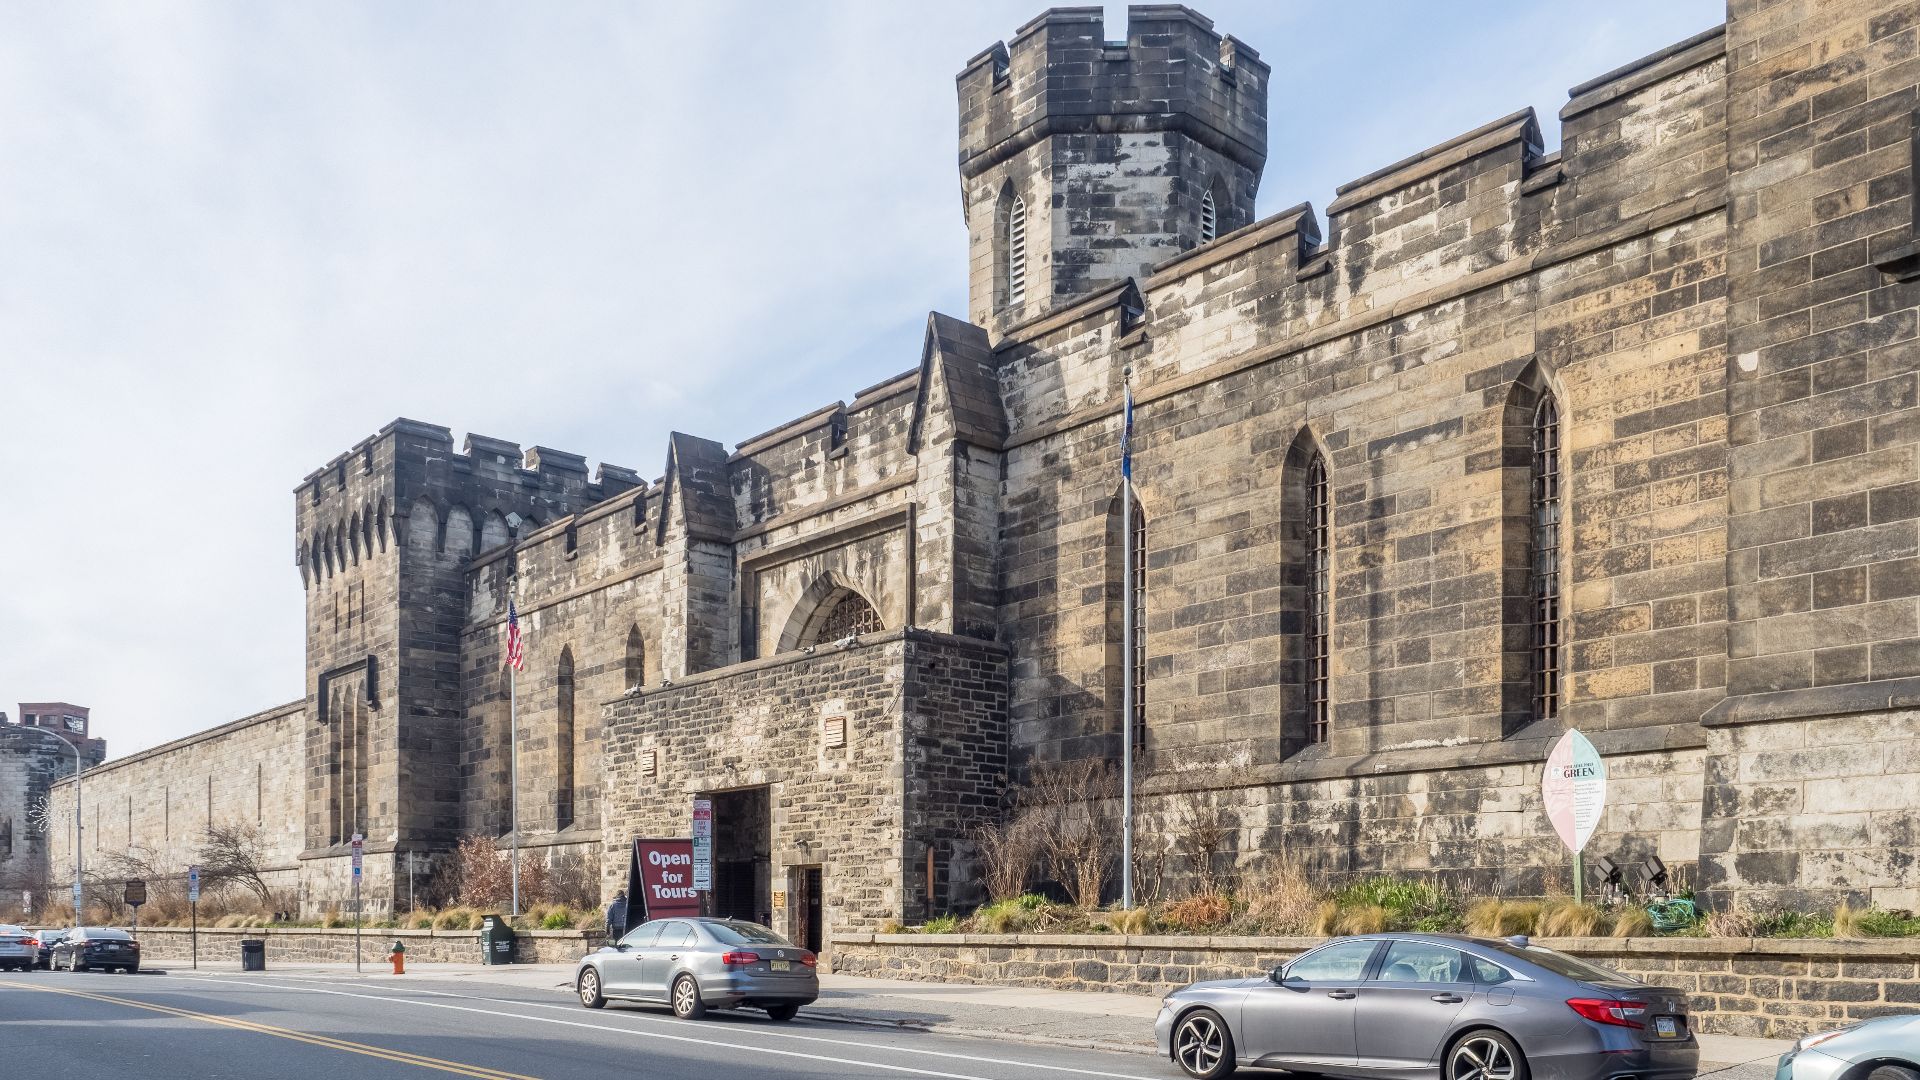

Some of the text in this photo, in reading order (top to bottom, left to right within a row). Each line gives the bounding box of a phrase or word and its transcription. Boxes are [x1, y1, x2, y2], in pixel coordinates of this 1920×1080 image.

[1564, 767, 1594, 778] GREEN
[649, 851, 690, 868] Open
[662, 871, 683, 883] for
[652, 885, 698, 898] Tours
